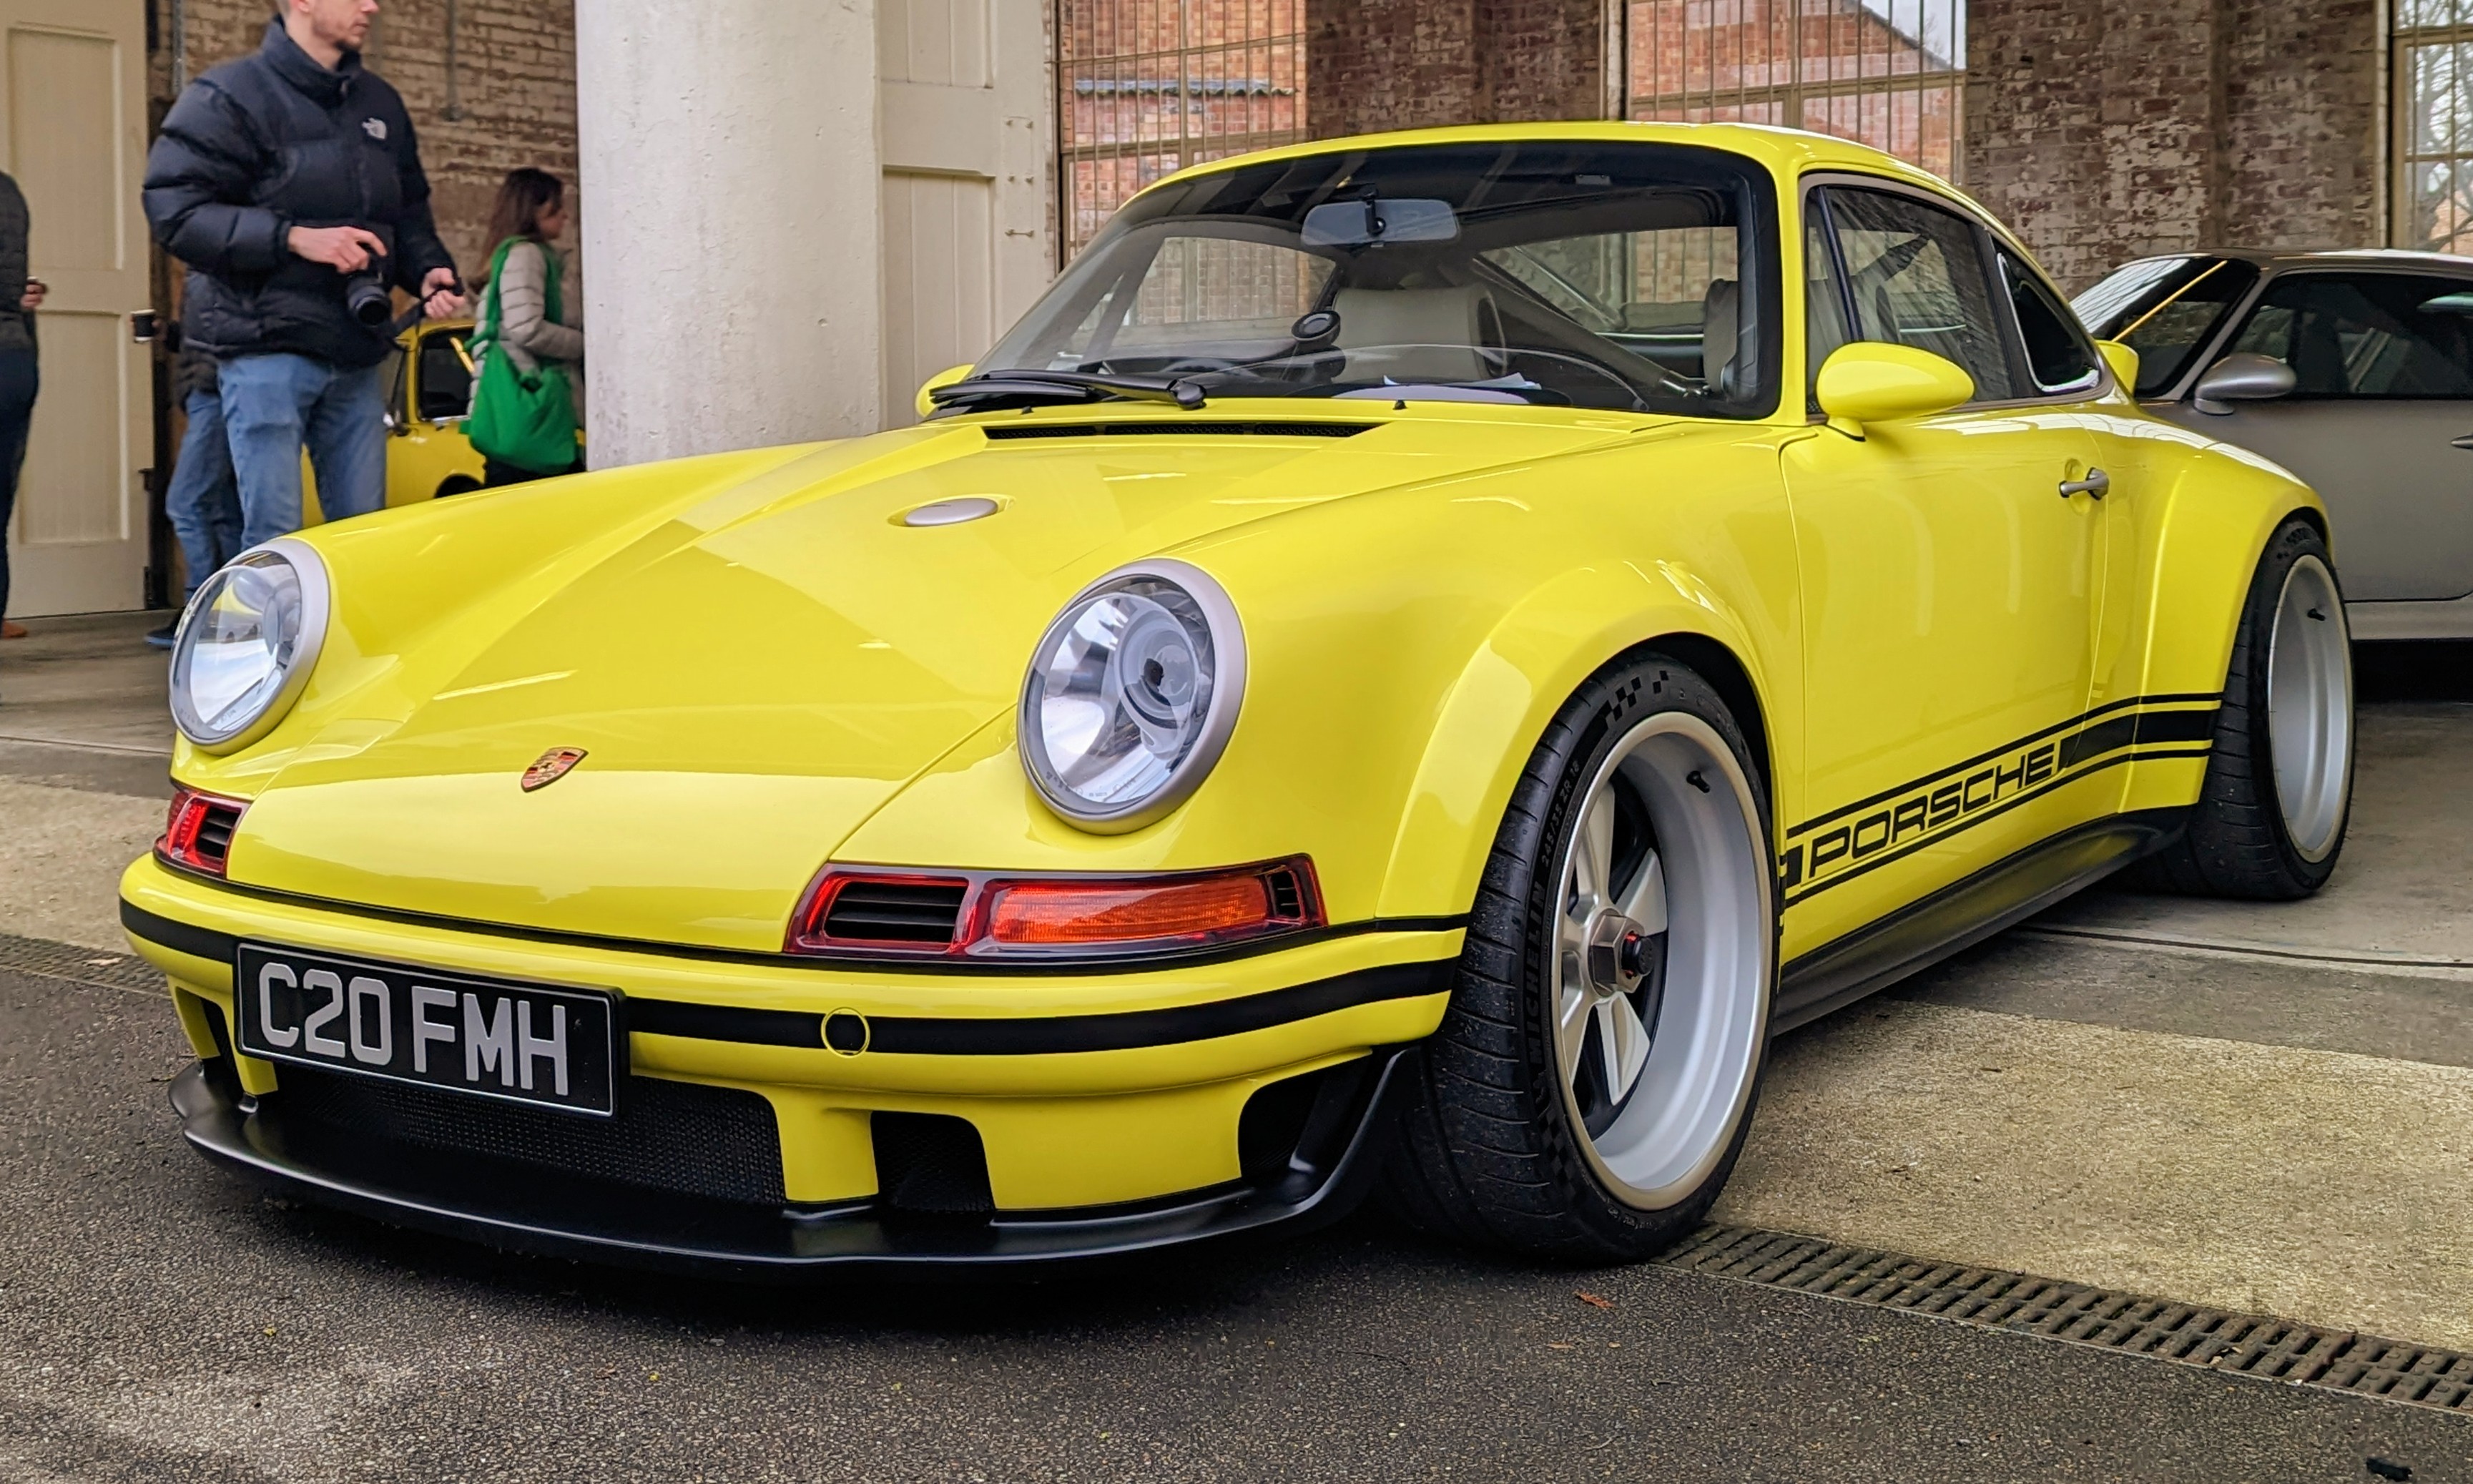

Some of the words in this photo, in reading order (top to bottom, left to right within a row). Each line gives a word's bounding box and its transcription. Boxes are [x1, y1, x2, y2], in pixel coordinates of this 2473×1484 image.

[1559, 780, 1573, 802] ZR
[1808, 742, 2056, 879] PORSCHE
[259, 962, 393, 1066] C20
[410, 985, 569, 1096] FMH
[1525, 880, 1546, 1066] MICHELIN
